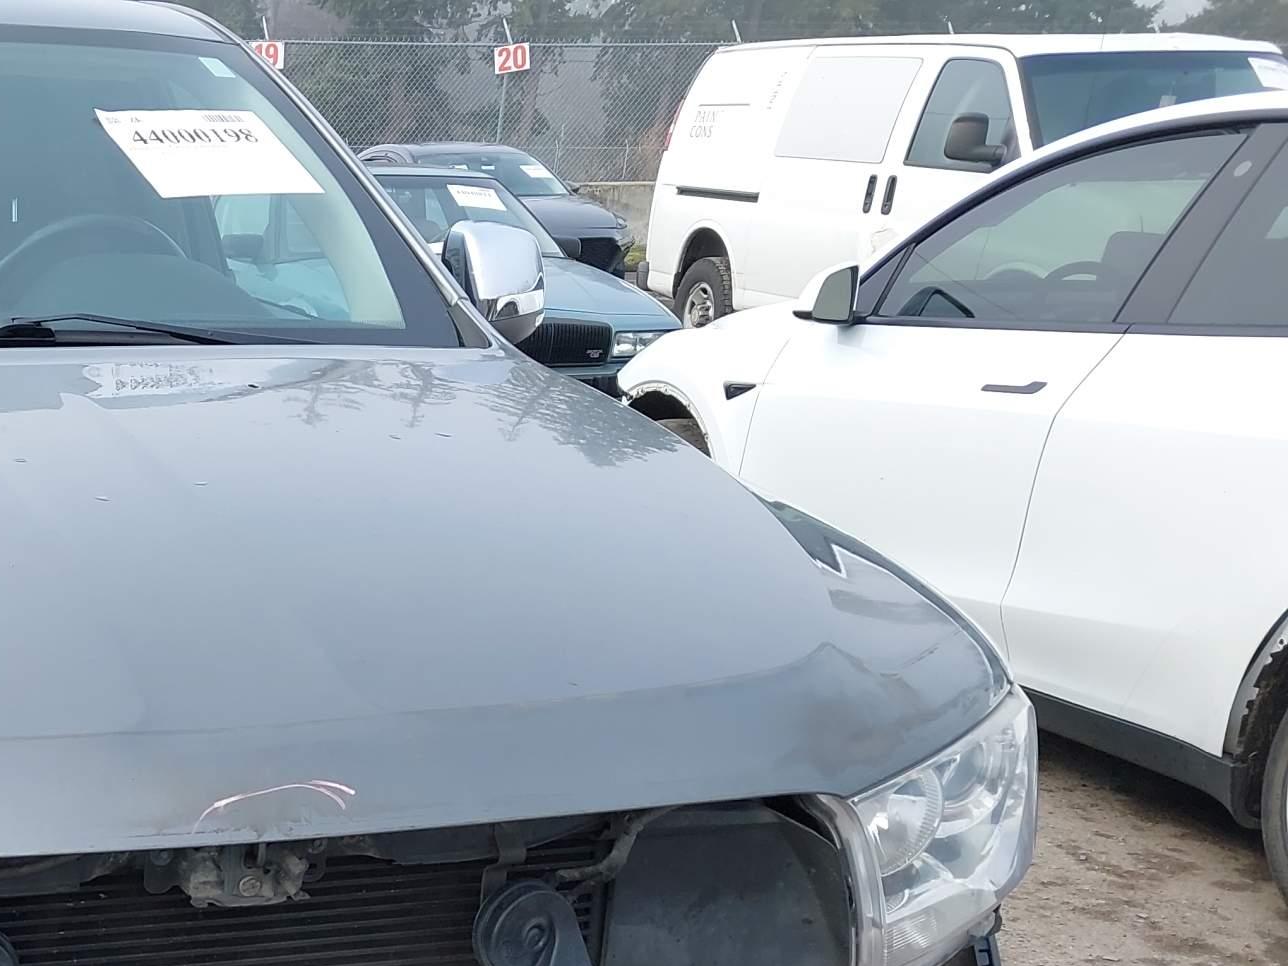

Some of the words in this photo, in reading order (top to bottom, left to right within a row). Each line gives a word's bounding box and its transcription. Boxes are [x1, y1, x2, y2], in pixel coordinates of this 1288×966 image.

[255, 43, 278, 66] 19
[498, 45, 527, 72] 20
[132, 128, 259, 146] 44000198
